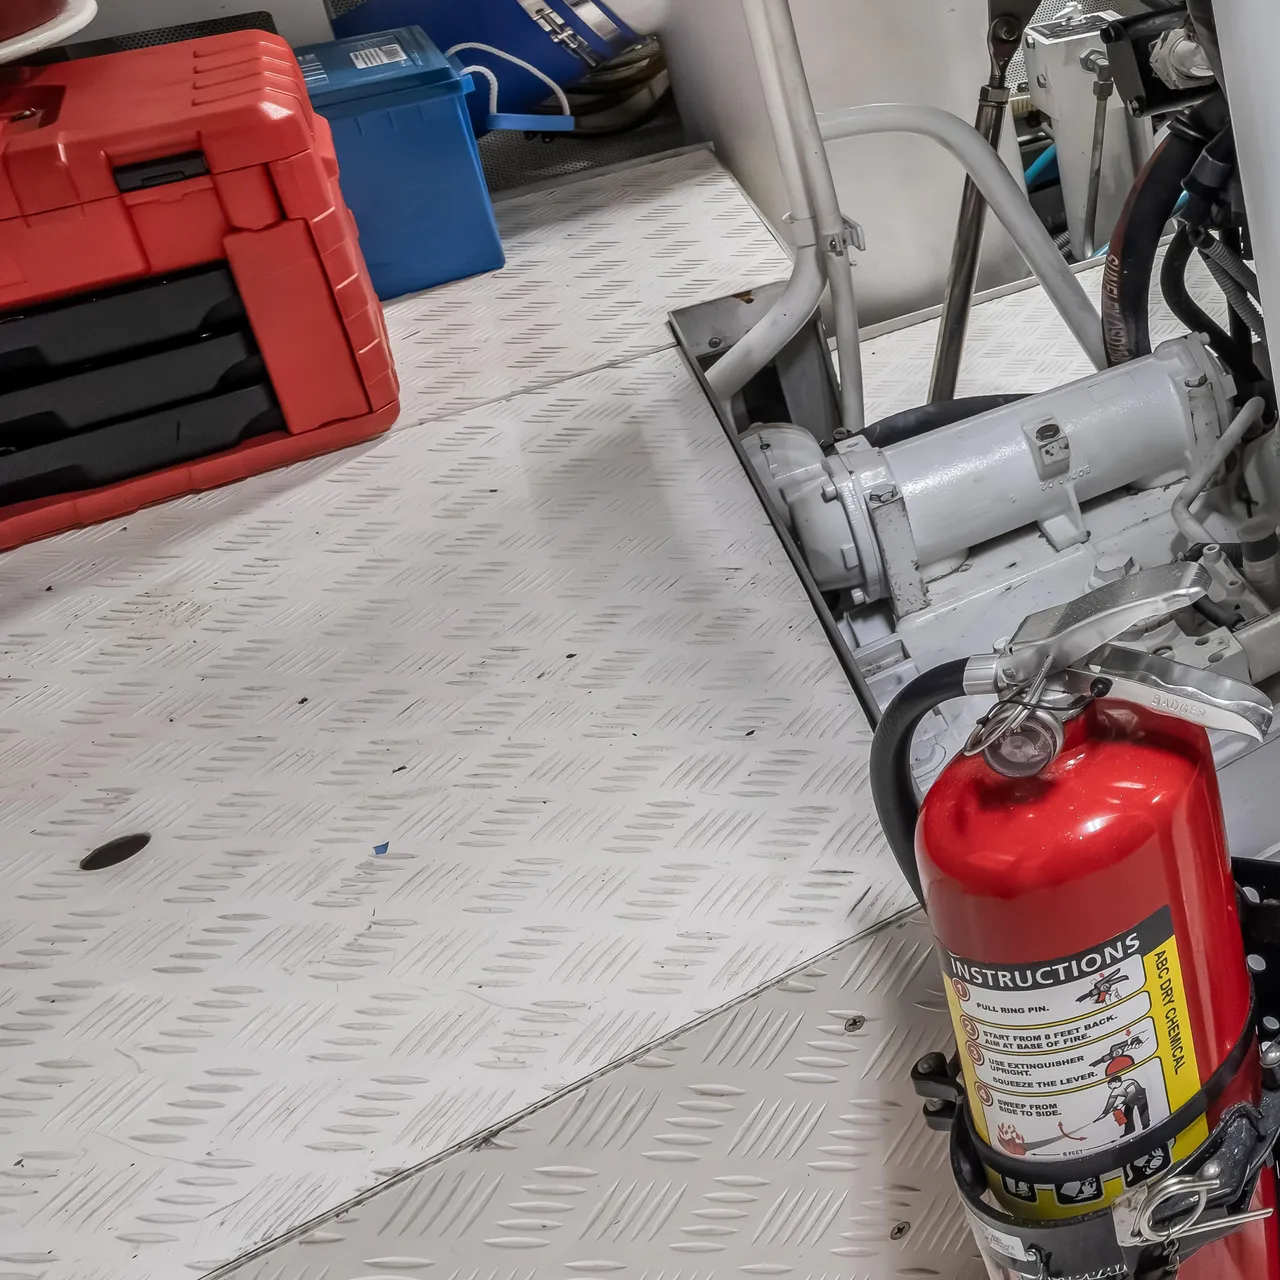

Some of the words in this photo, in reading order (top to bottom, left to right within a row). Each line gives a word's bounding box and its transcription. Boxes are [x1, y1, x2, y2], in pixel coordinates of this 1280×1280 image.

[1150, 693, 1207, 718] BADGER
[950, 932, 1140, 988] INSTRUCTIONS
[1154, 949, 1170, 980] ABC
[1160, 977, 1176, 1008] DRY
[976, 1002, 999, 1013] PULL
[1000, 1006, 1025, 1014] RING
[1027, 1005, 1049, 1013] PIN.
[982, 1030, 1011, 1041] START
[1013, 1034, 1042, 1042] FROM
[1054, 1027, 1081, 1038] FEET
[1084, 1014, 1118, 1030] BACK.
[984, 1038, 1000, 1047] AIM
[1002, 1042, 1014, 1050] AT
[1016, 1042, 1043, 1050] BASE
[1046, 1040, 1060, 1048] OF
[1063, 1034, 1091, 1045] FIRE.
[1164, 1006, 1186, 1076] CHEMICAL
[988, 1058, 1006, 1068] USE
[1008, 1055, 1085, 1070] EXTINGUISHER
[990, 1064, 1032, 1076] UPRIGHT.
[992, 1077, 1034, 1088] SQUEEZE
[1060, 1071, 1098, 1086] LEVER.
[998, 1099, 1027, 1110] SWEEP
[998, 1106, 1020, 1116] SIDE
[1068, 1149, 1083, 1157] FEET
